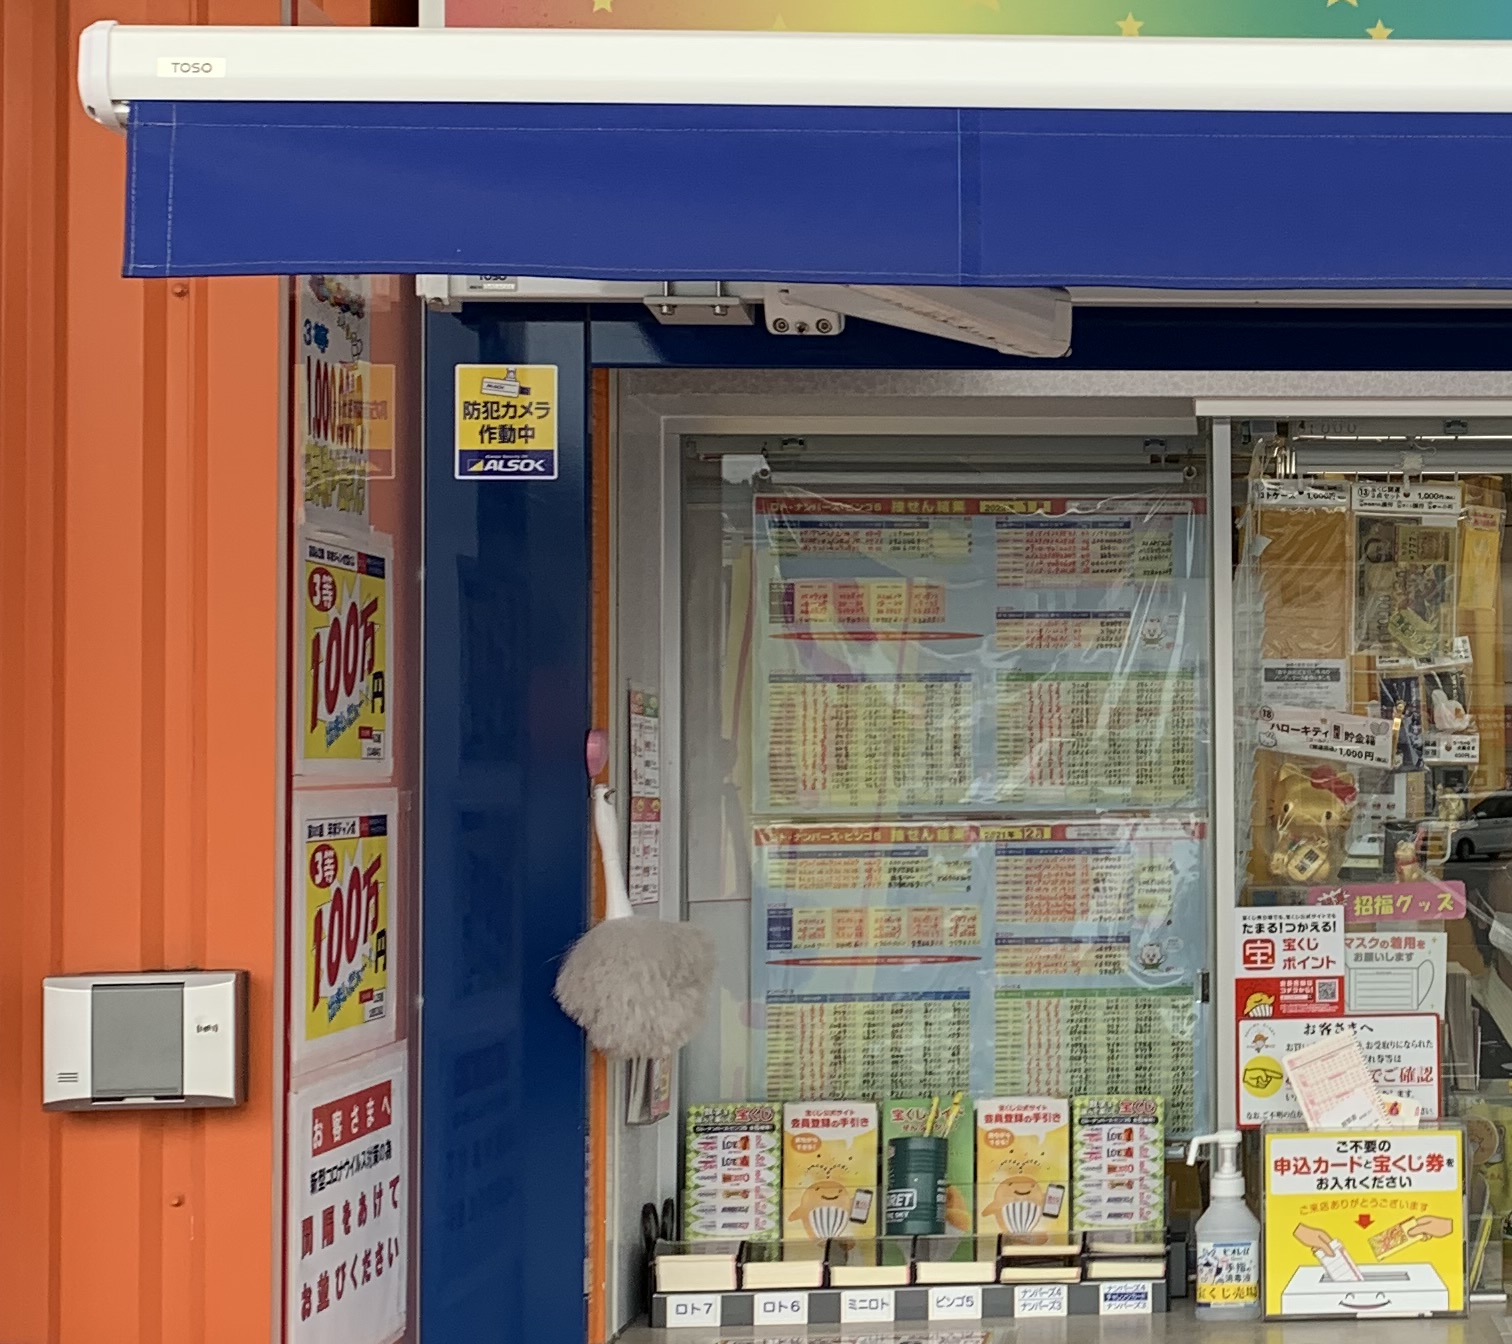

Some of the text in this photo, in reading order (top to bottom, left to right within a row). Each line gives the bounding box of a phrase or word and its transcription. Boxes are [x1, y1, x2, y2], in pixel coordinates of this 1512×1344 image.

[171, 62, 213, 74] TOSO
[463, 400, 551, 420] 防犯カメラ
[479, 424, 535, 444] 作動中
[484, 459, 546, 472] ALSOK
[1270, 722, 1330, 739] ハローキティ
[1339, 747, 1375, 761] 1,000円
[1354, 893, 1455, 916] 招福グッズ
[1242, 921, 1337, 935] たまる!つかえる!
[1283, 938, 1319, 952] 宝くじ
[1283, 956, 1337, 970] ポイント
[1353, 952, 1415, 963] お願いします
[313, 1096, 391, 1149] お客さまへ
[790, 1117, 870, 1130] 会員登録の手引き
[984, 1112, 1062, 1124] 会員登録の手引き
[1336, 1140, 1391, 1153] ご不要の
[1274, 1153, 1455, 1175] 申込カードと宝くじ券を
[1316, 1176, 1412, 1190] お入れください
[1300, 1198, 1429, 1215] ご来店ありがとうございます
[301, 1237, 400, 1322] お並びください
[1020, 1287, 1062, 1298] ナンバーズ4
[763, 1301, 801, 1313] ロト6
[848, 1298, 890, 1311] ミニロト
[936, 1294, 975, 1308] ビンゴ5
[1020, 1300, 1063, 1311] ナンバーズ3
[676, 1303, 713, 1315] ロト7
